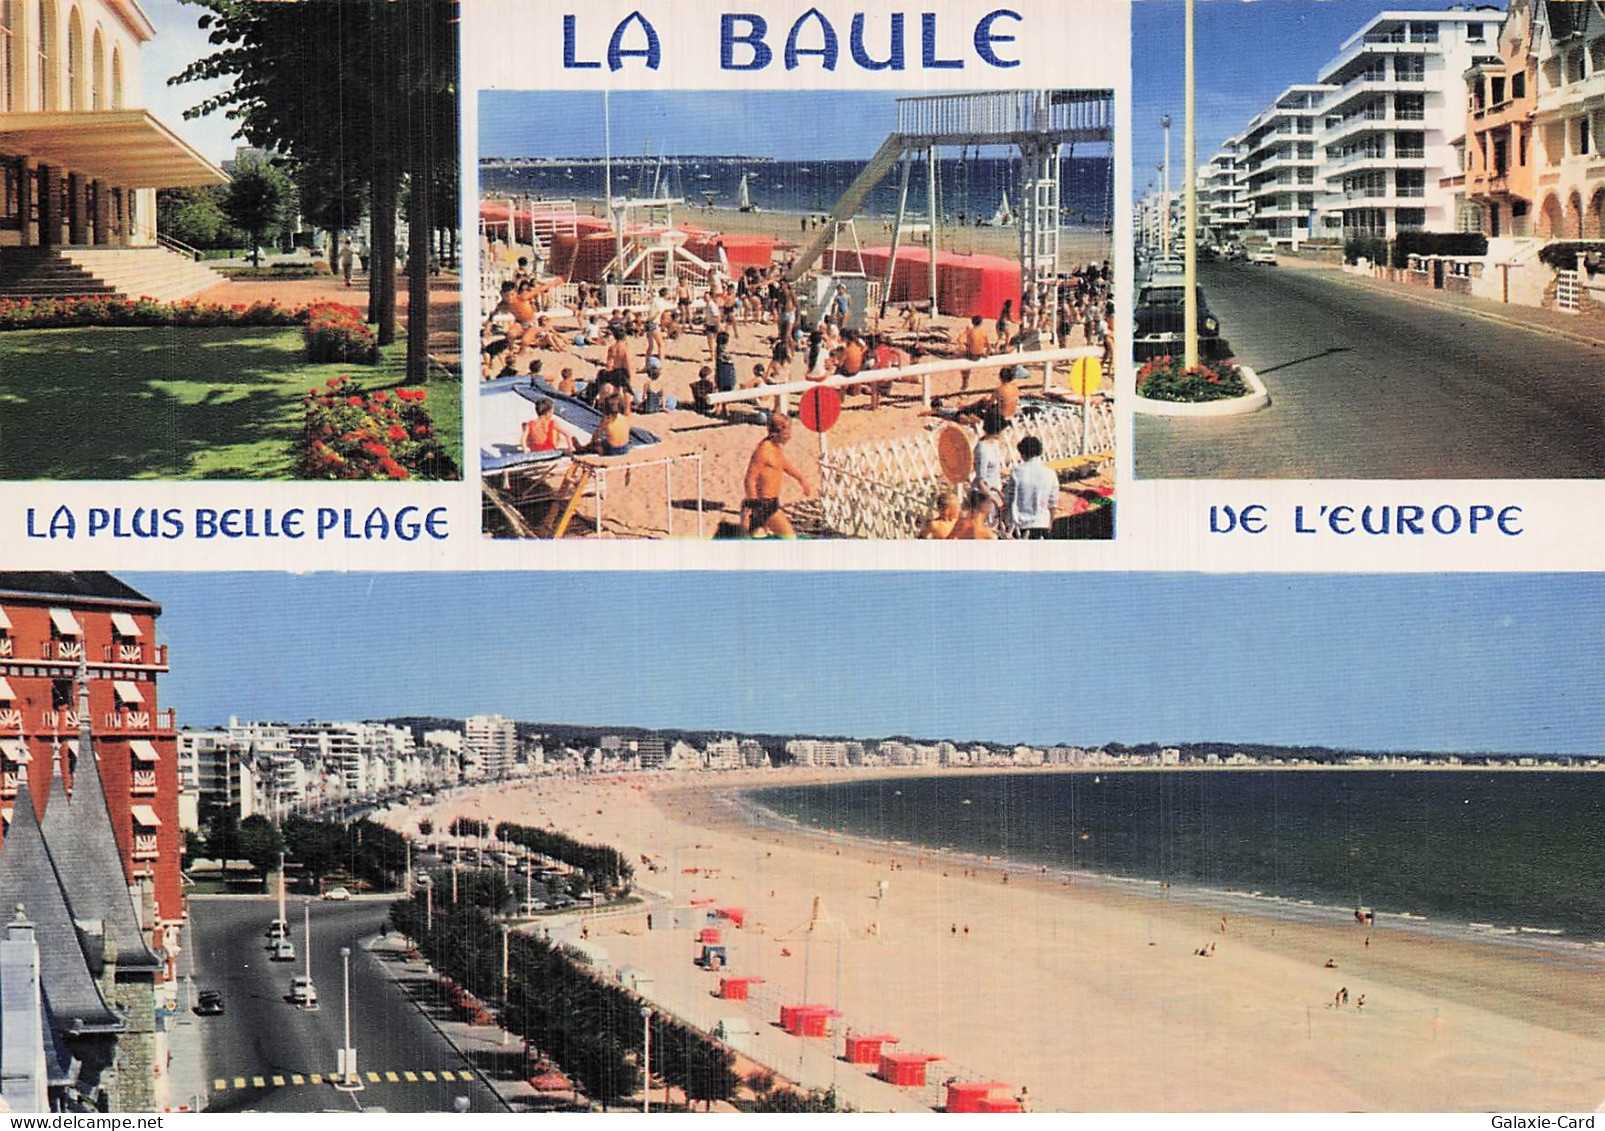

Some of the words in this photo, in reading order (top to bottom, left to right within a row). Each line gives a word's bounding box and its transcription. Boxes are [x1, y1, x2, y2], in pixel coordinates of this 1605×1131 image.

[563, 11, 660, 72] LA
[721, 8, 1022, 72] BAULE
[27, 505, 75, 540] LA
[89, 507, 185, 540] PLUS
[196, 508, 305, 539] BELLE
[317, 506, 449, 541] PLAGE
[1210, 505, 1267, 535] DE
[1295, 505, 1524, 536] L'EUROPE
